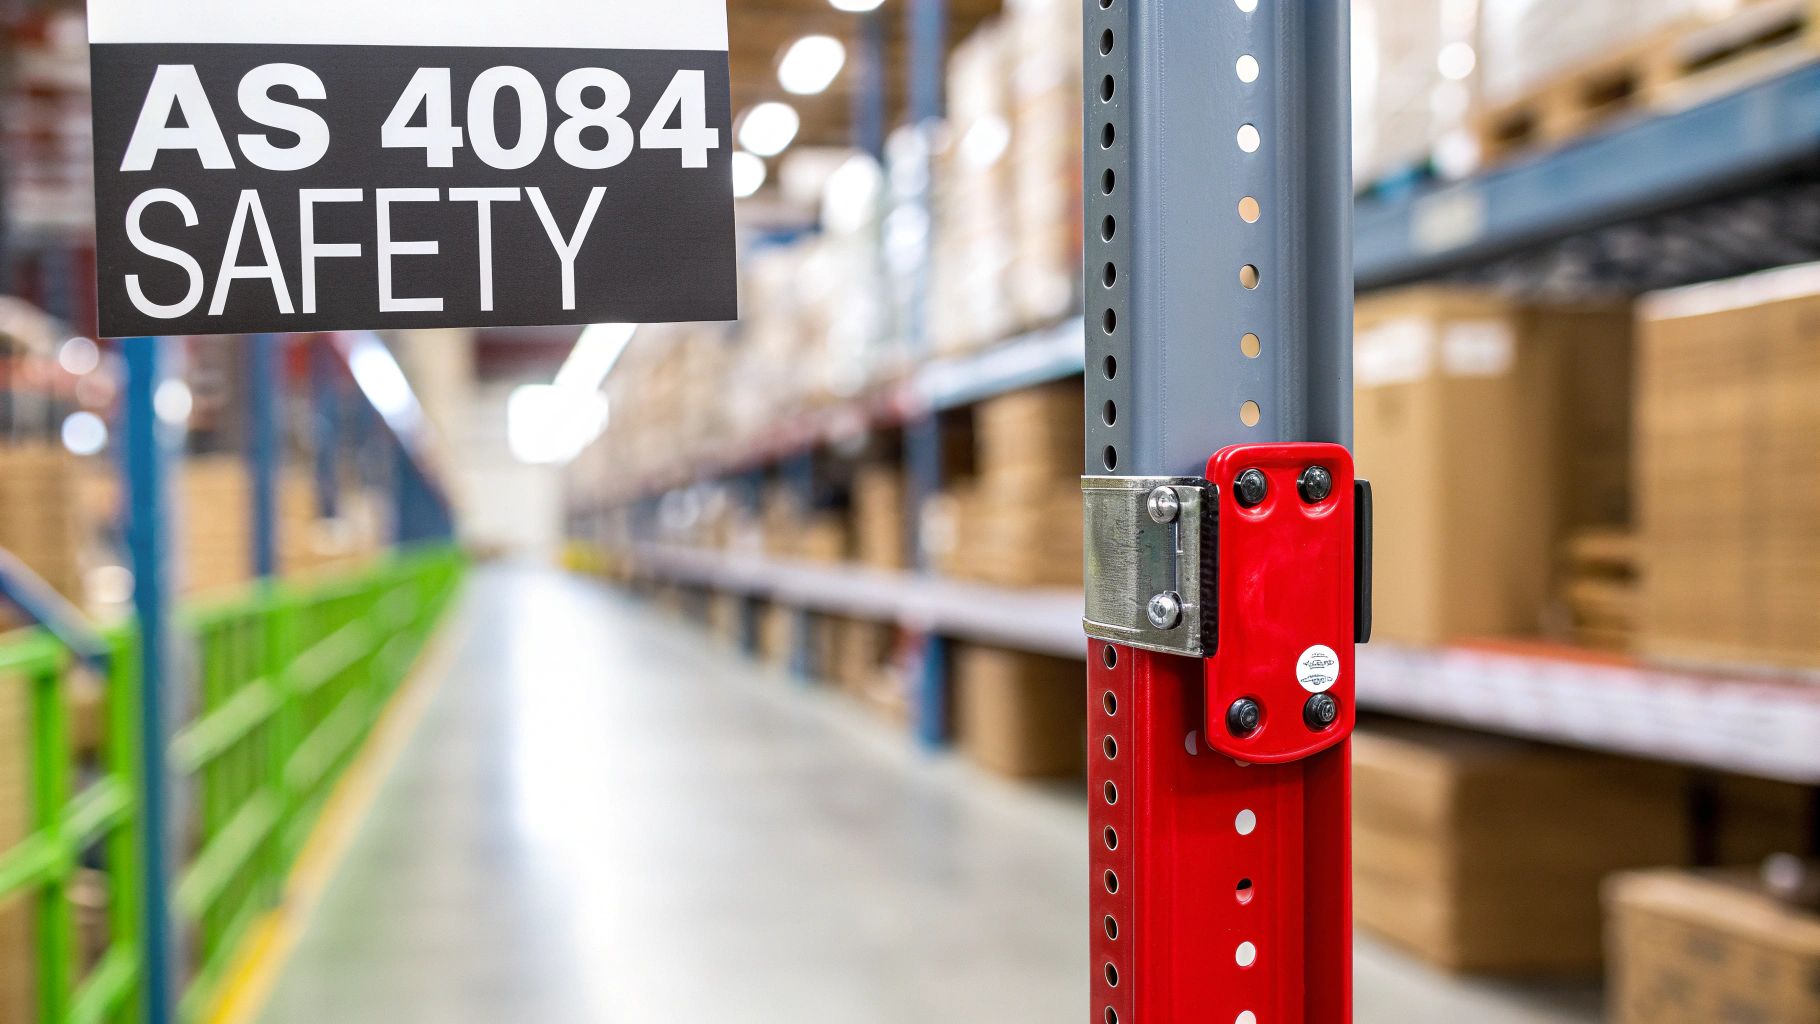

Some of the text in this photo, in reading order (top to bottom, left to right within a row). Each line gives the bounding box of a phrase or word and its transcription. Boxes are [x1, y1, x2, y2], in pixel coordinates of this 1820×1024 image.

[120, 63, 719, 171] AS 4084
[125, 187, 607, 318] SAFETY
